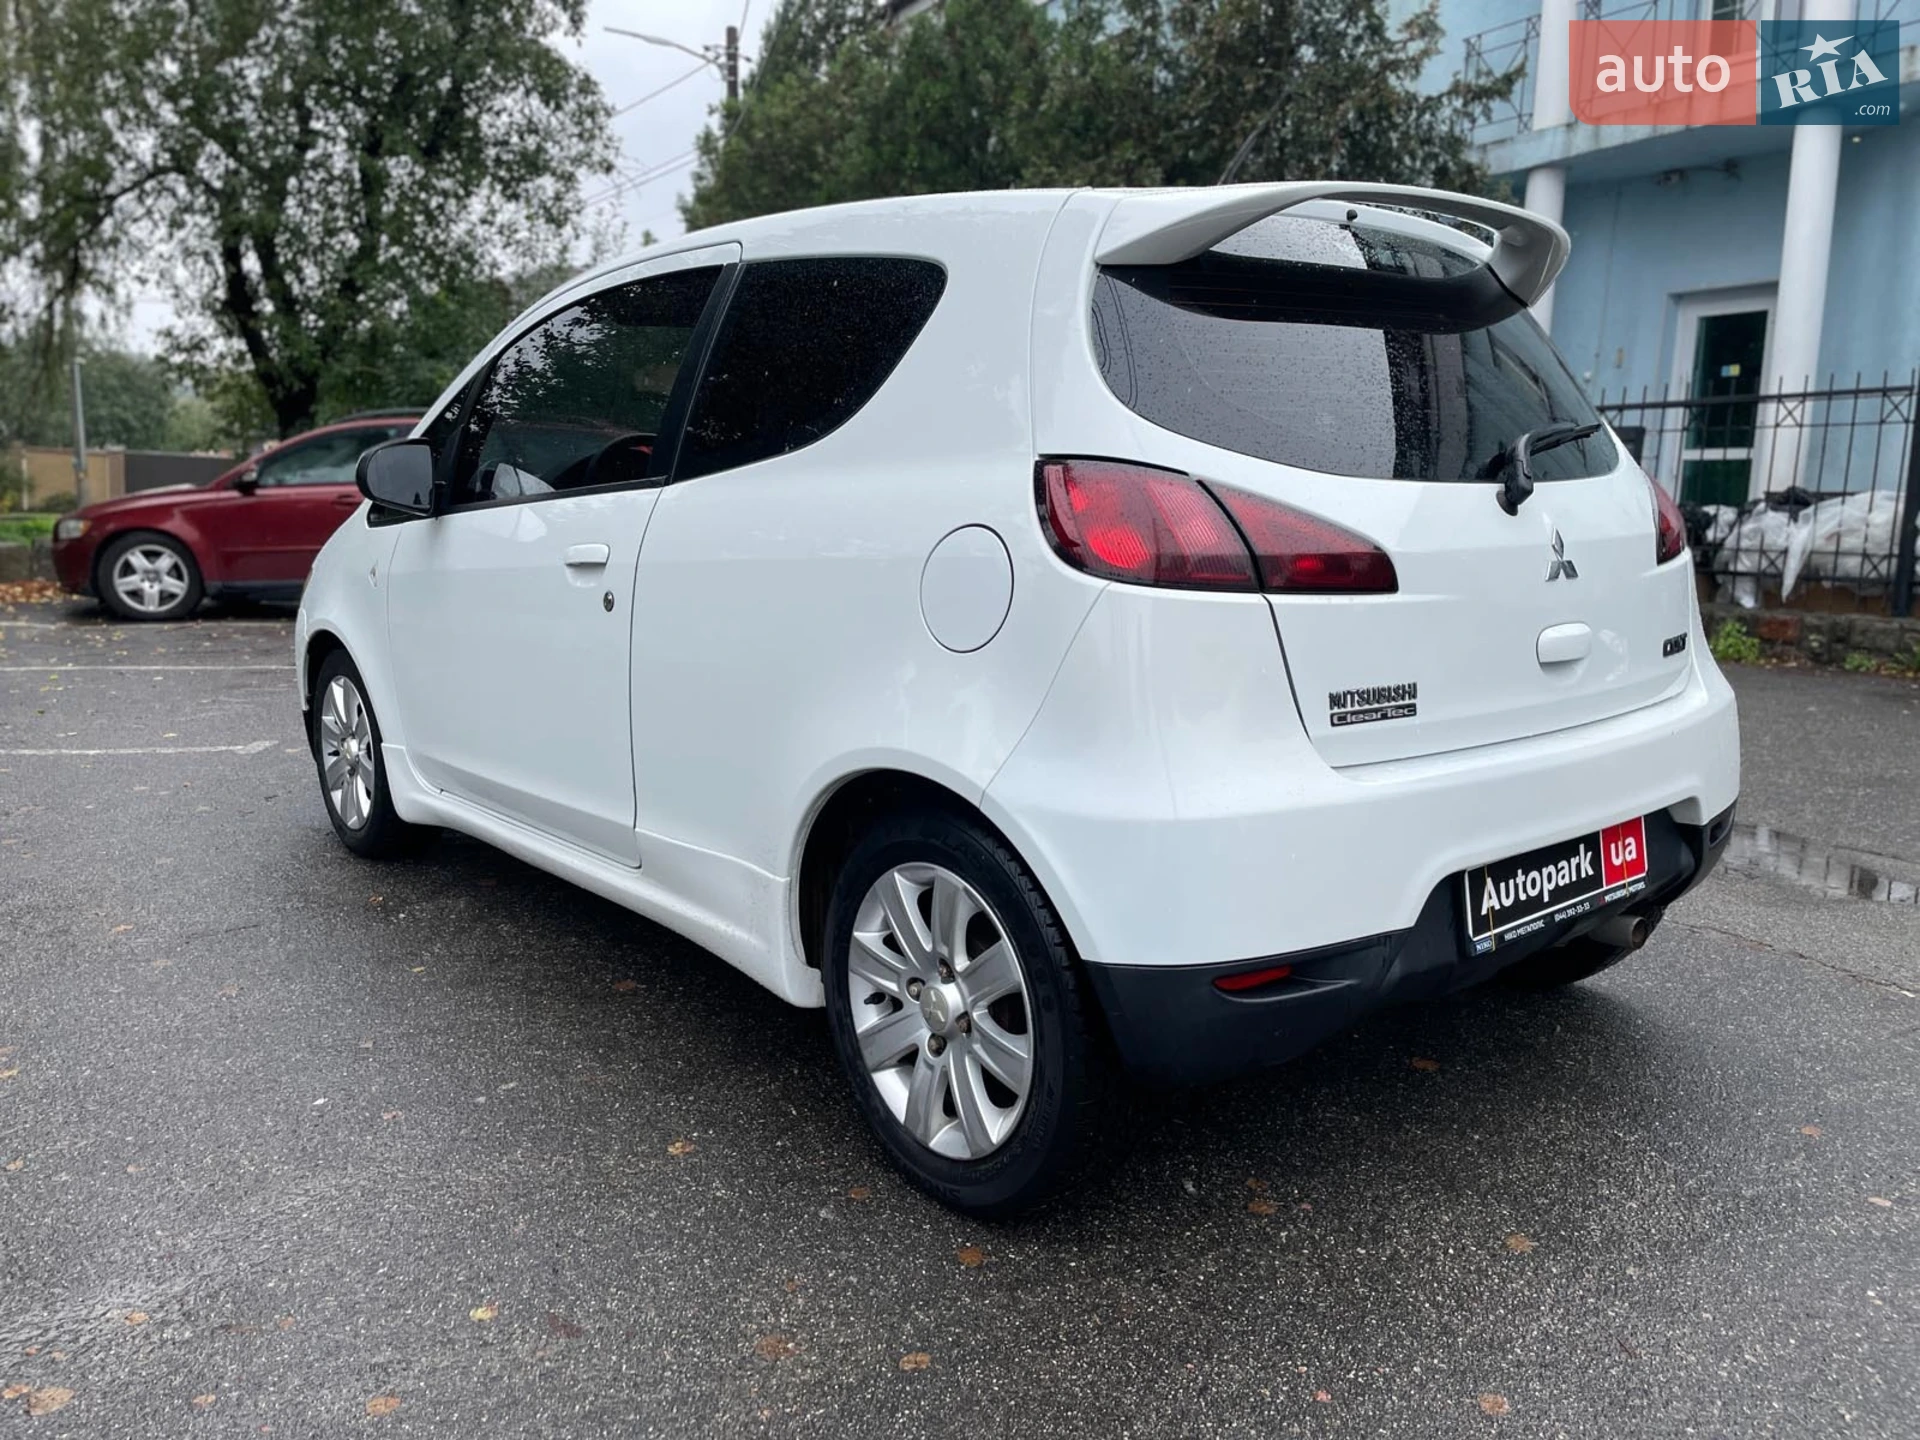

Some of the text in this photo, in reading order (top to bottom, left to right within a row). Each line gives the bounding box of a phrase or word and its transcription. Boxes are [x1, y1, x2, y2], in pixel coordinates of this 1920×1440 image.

[1328, 682, 1418, 711] MITSUBISHI
[1331, 706, 1416, 725] ClearTec
[1480, 836, 1637, 916] Autopark ua
